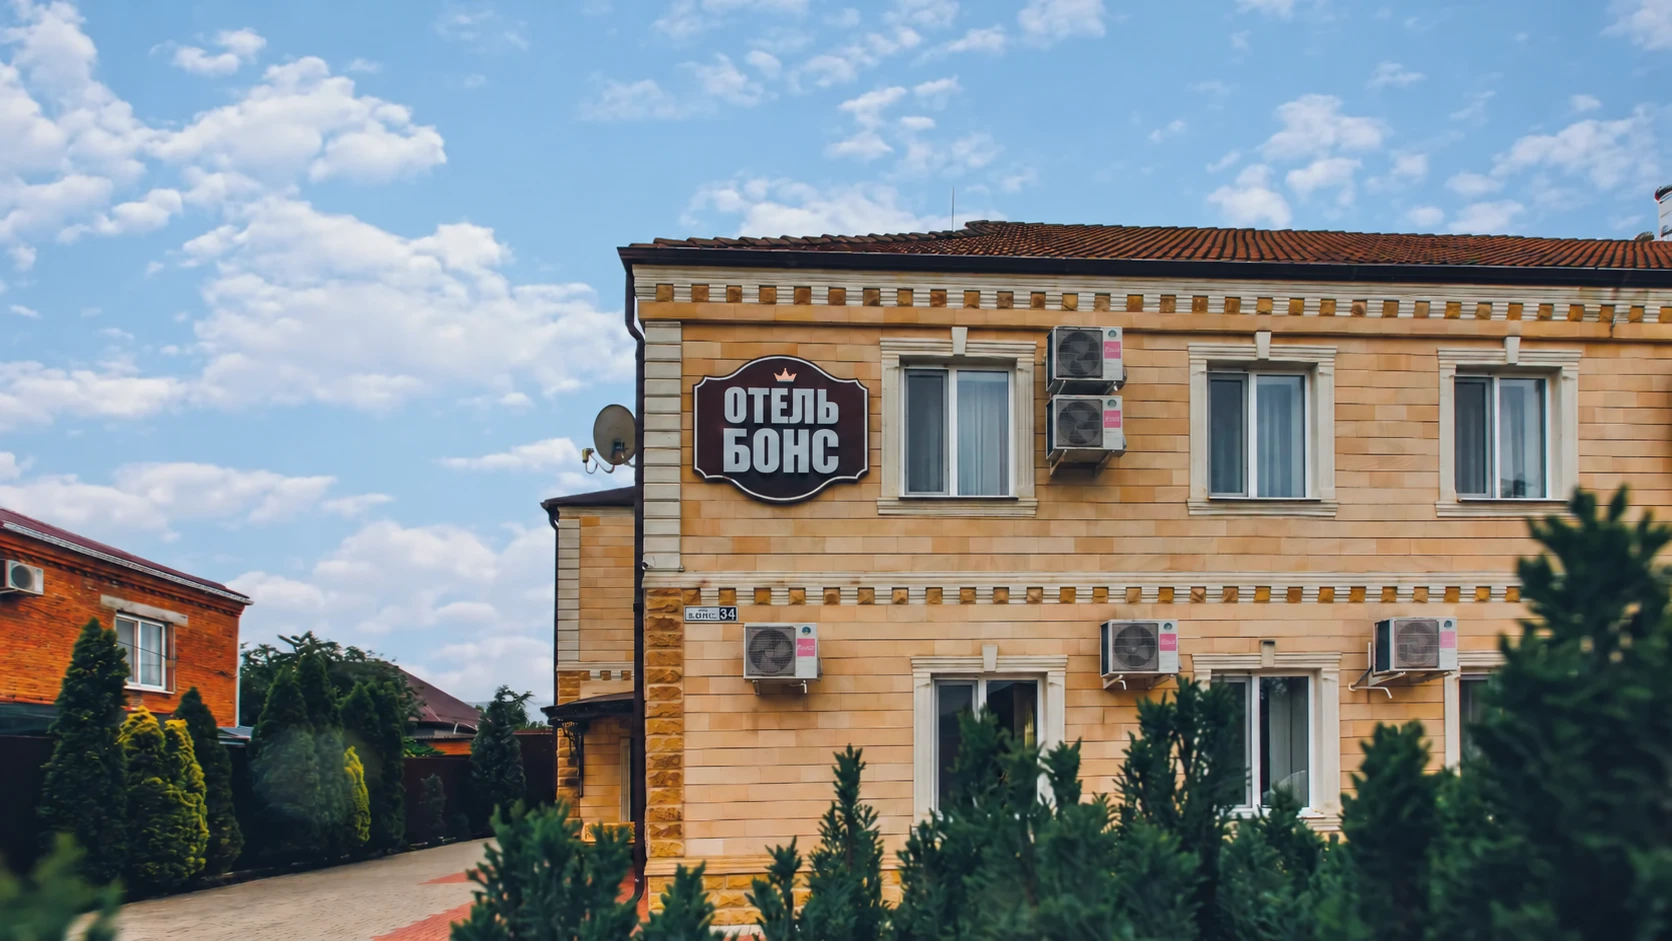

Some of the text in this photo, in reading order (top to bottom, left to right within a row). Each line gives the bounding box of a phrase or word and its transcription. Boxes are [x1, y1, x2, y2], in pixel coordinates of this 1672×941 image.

[724, 386, 839, 424] ОТЕЛЬ
[723, 428, 839, 474] БОНС
[720, 608, 735, 620] 34
